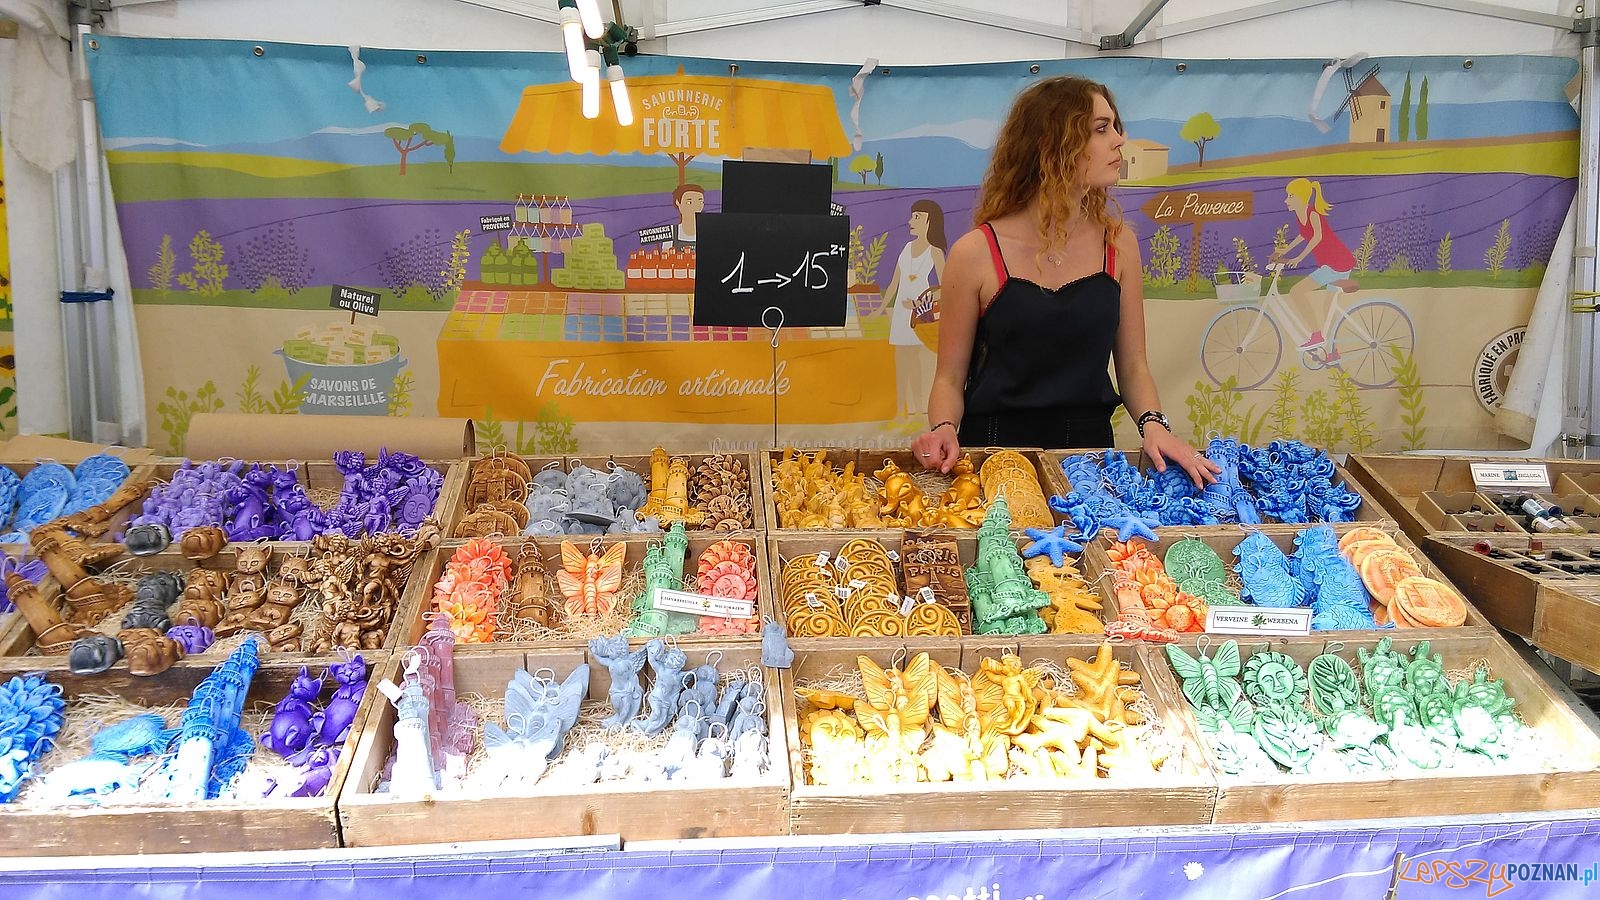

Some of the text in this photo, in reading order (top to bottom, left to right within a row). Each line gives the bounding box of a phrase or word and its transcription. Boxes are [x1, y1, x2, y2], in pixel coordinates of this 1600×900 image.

[641, 89, 723, 111] SAVONNERIE
[643, 117, 720, 149] FORTE
[1154, 193, 1245, 219] La Provence
[482, 222, 510, 231] PROVENCE
[639, 225, 671, 237] SAVONNERIE
[720, 250, 754, 294] 1
[340, 288, 375, 305] Naturel
[339, 299, 375, 314] ou Olive
[535, 359, 791, 398] Fabrication artisanale
[1478, 351, 1499, 406] FABRIQUÉ
[1491, 339, 1509, 357] EN
[310, 377, 377, 392] SAVONS DE
[1216, 615, 1299, 625] VERVEINE WERBENA
